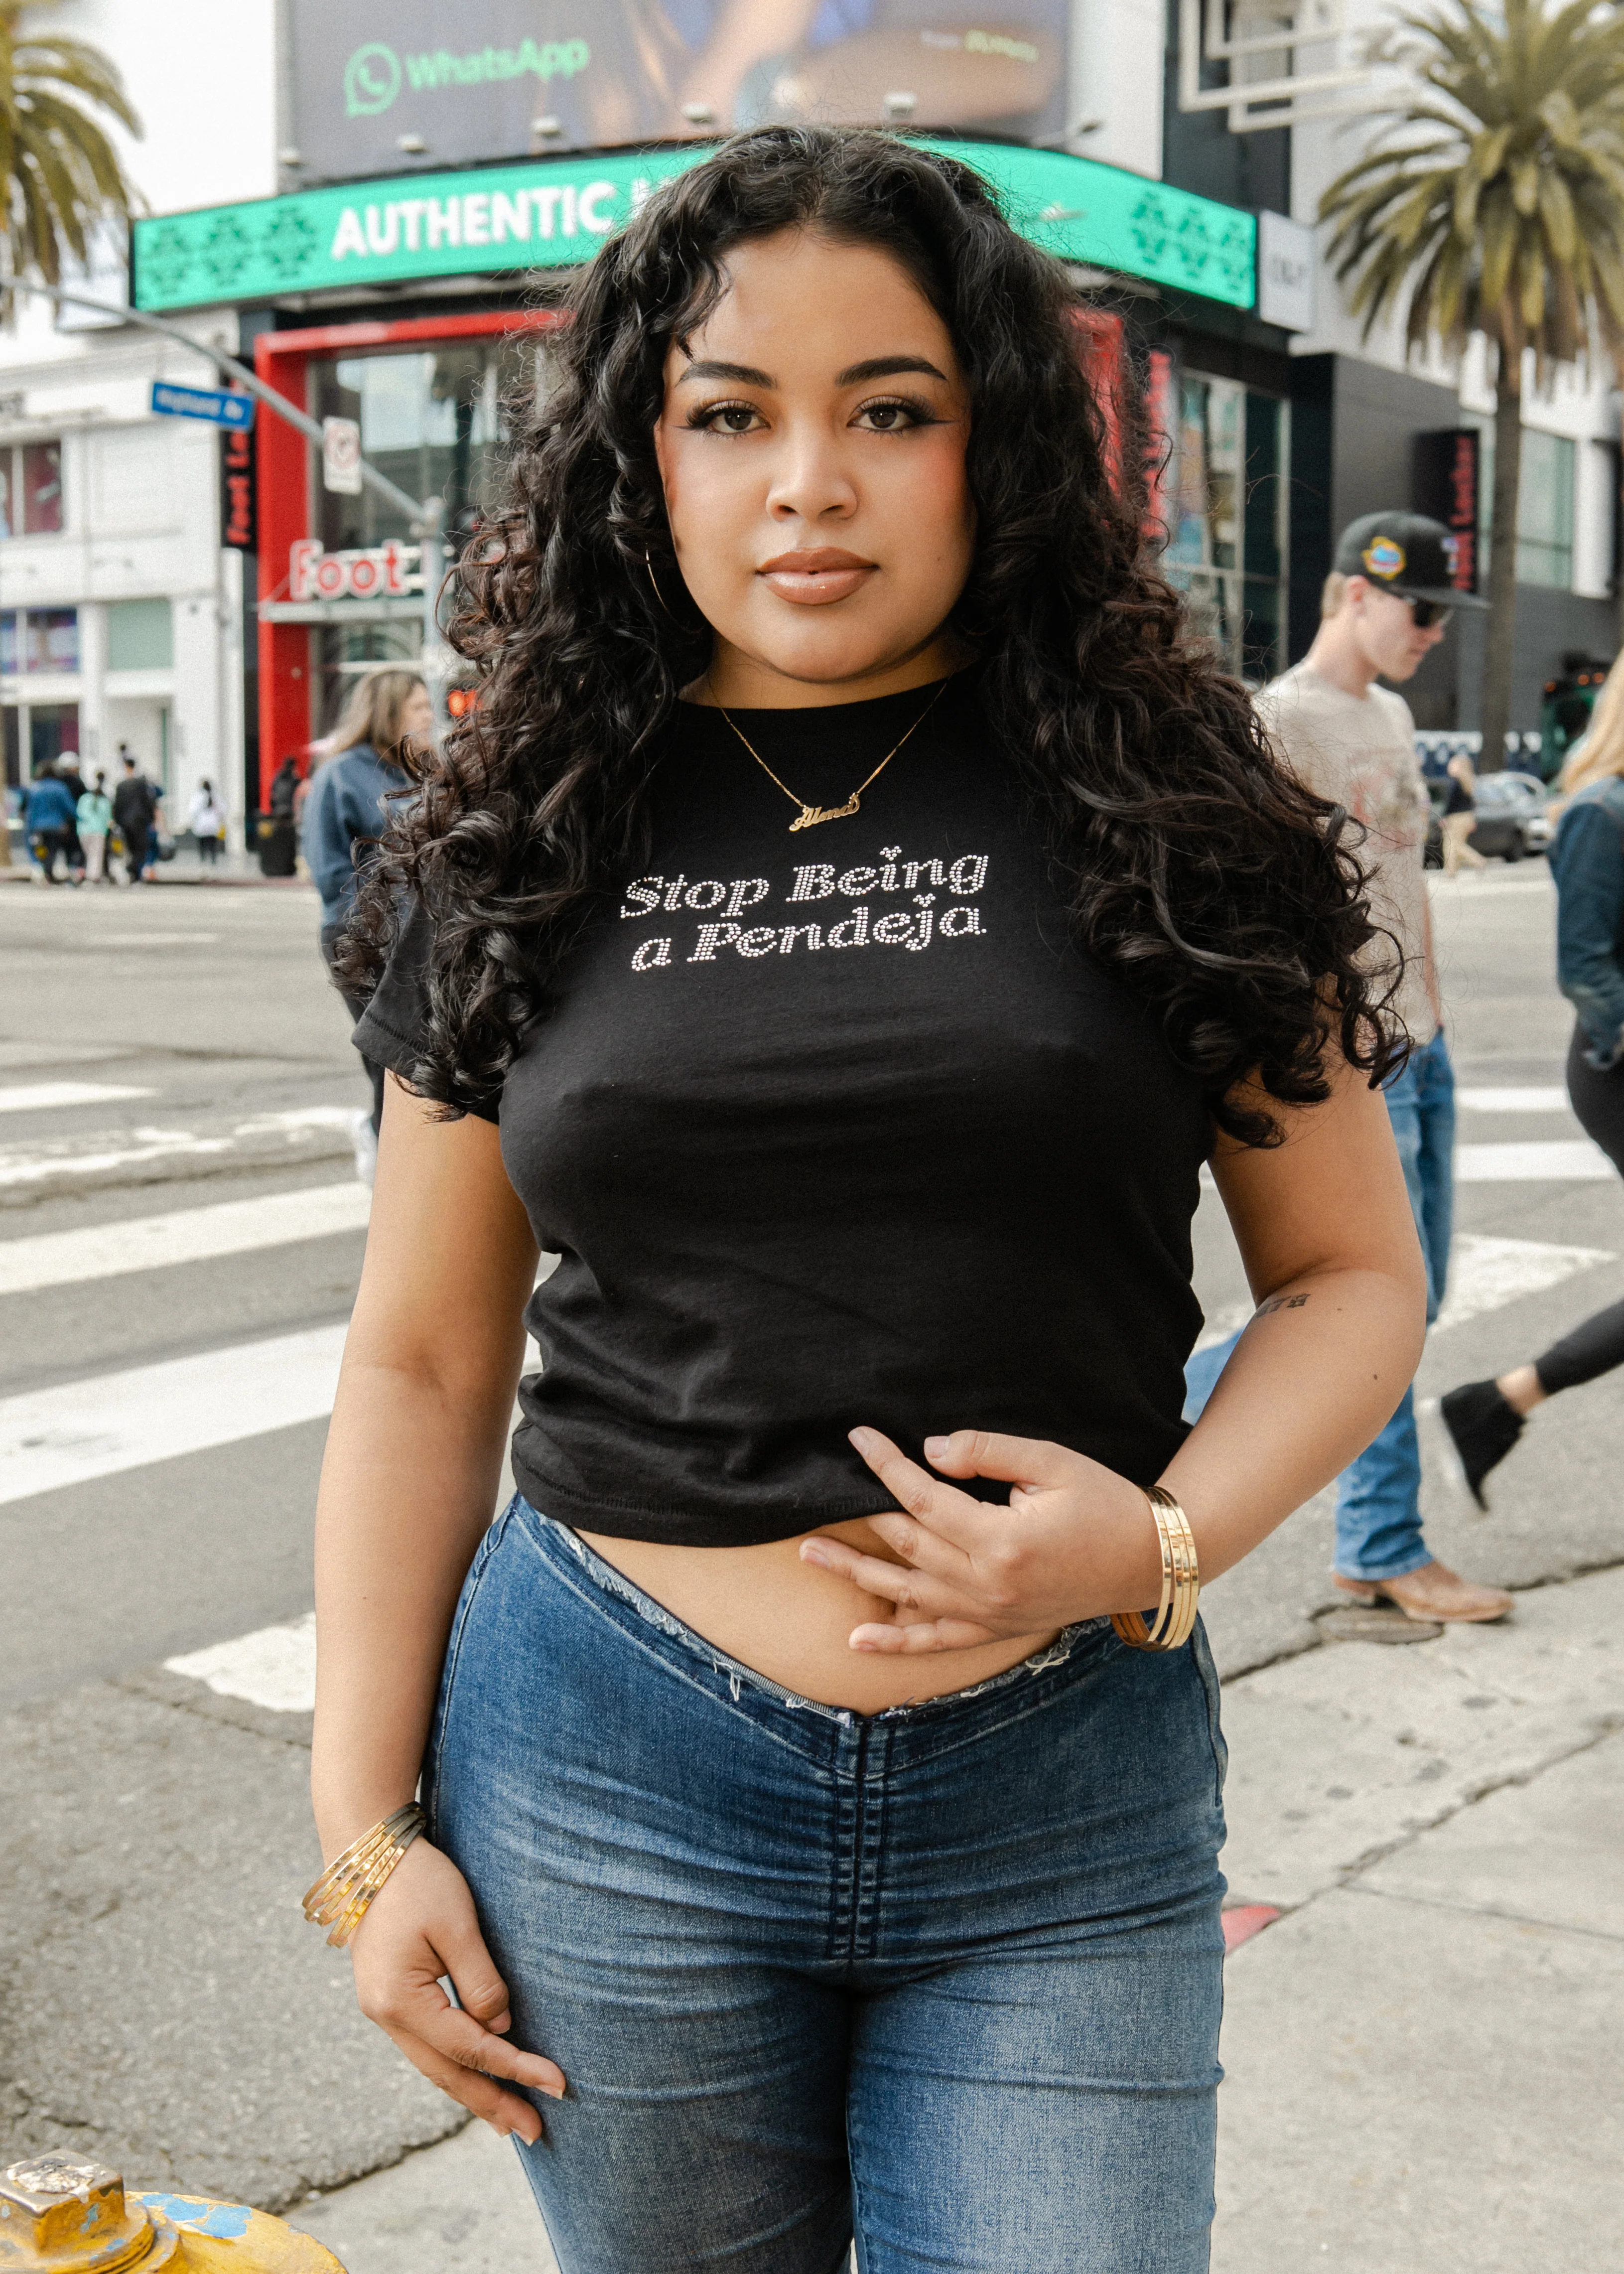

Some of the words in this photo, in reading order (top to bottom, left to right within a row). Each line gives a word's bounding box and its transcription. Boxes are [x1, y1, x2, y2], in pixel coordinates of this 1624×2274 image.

[406, 37, 590, 91] WhatsApp
[330, 181, 618, 261] AUTHENTIC
[789, 796, 860, 832] Alma
[620, 873, 769, 919] Stop
[786, 846, 989, 902] Being
[631, 937, 672, 972] a
[686, 893, 986, 962] Pendeja
